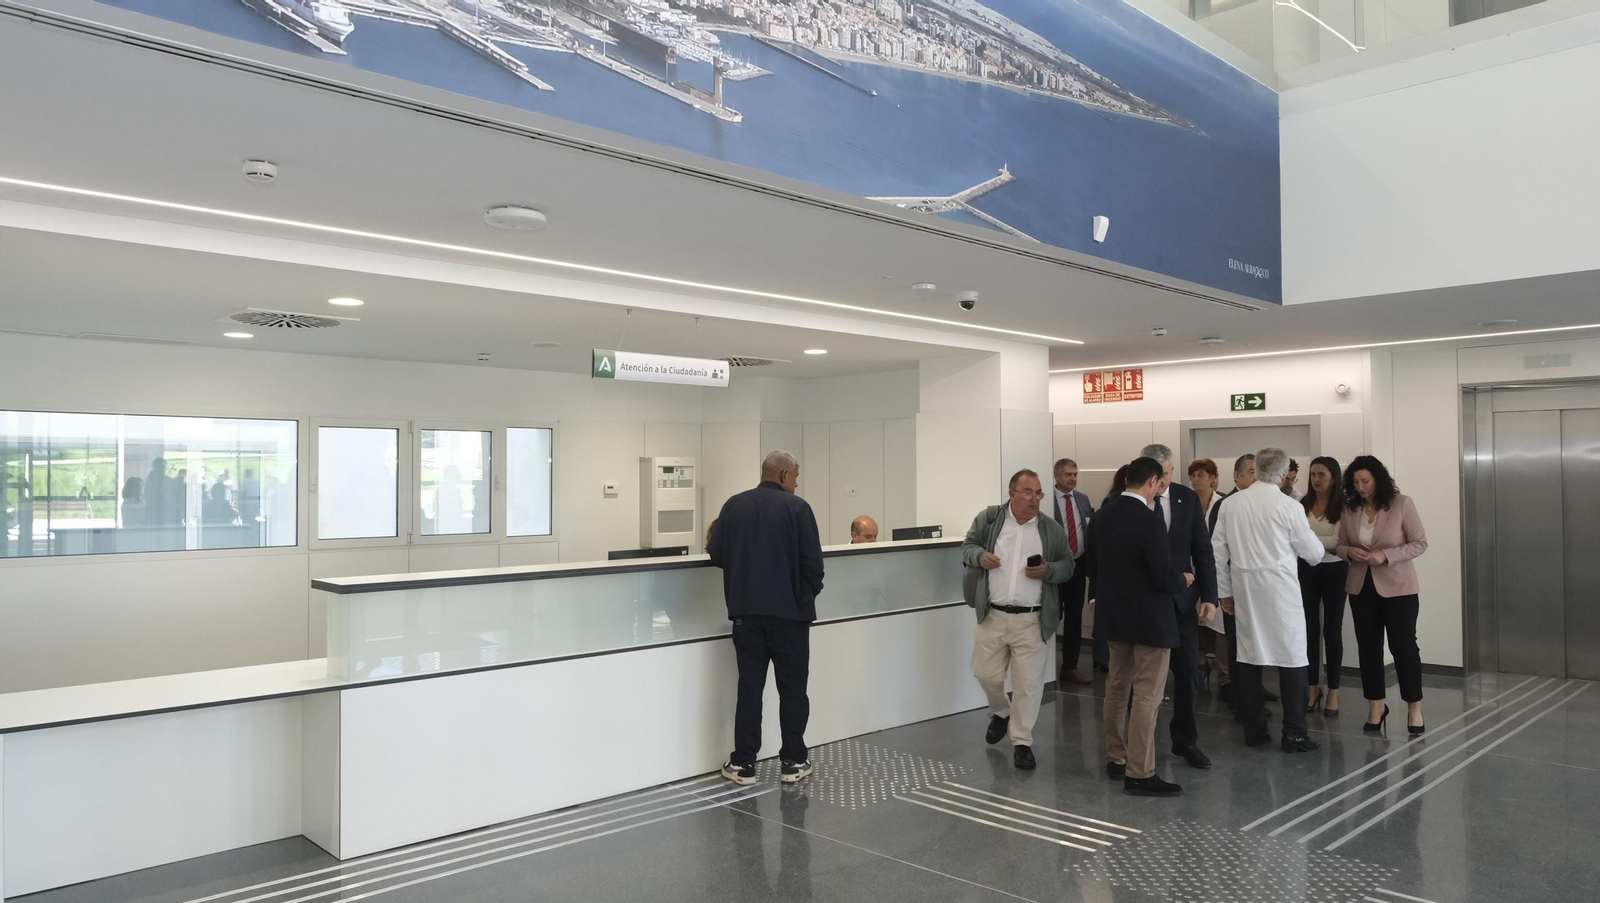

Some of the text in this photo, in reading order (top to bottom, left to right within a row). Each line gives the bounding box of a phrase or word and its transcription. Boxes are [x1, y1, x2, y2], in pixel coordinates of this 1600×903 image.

[1228, 258, 1244, 271] ELENA
[620, 362, 652, 373] Atención
[660, 366, 667, 374] la
[669, 366, 708, 377] Ciudadanía
